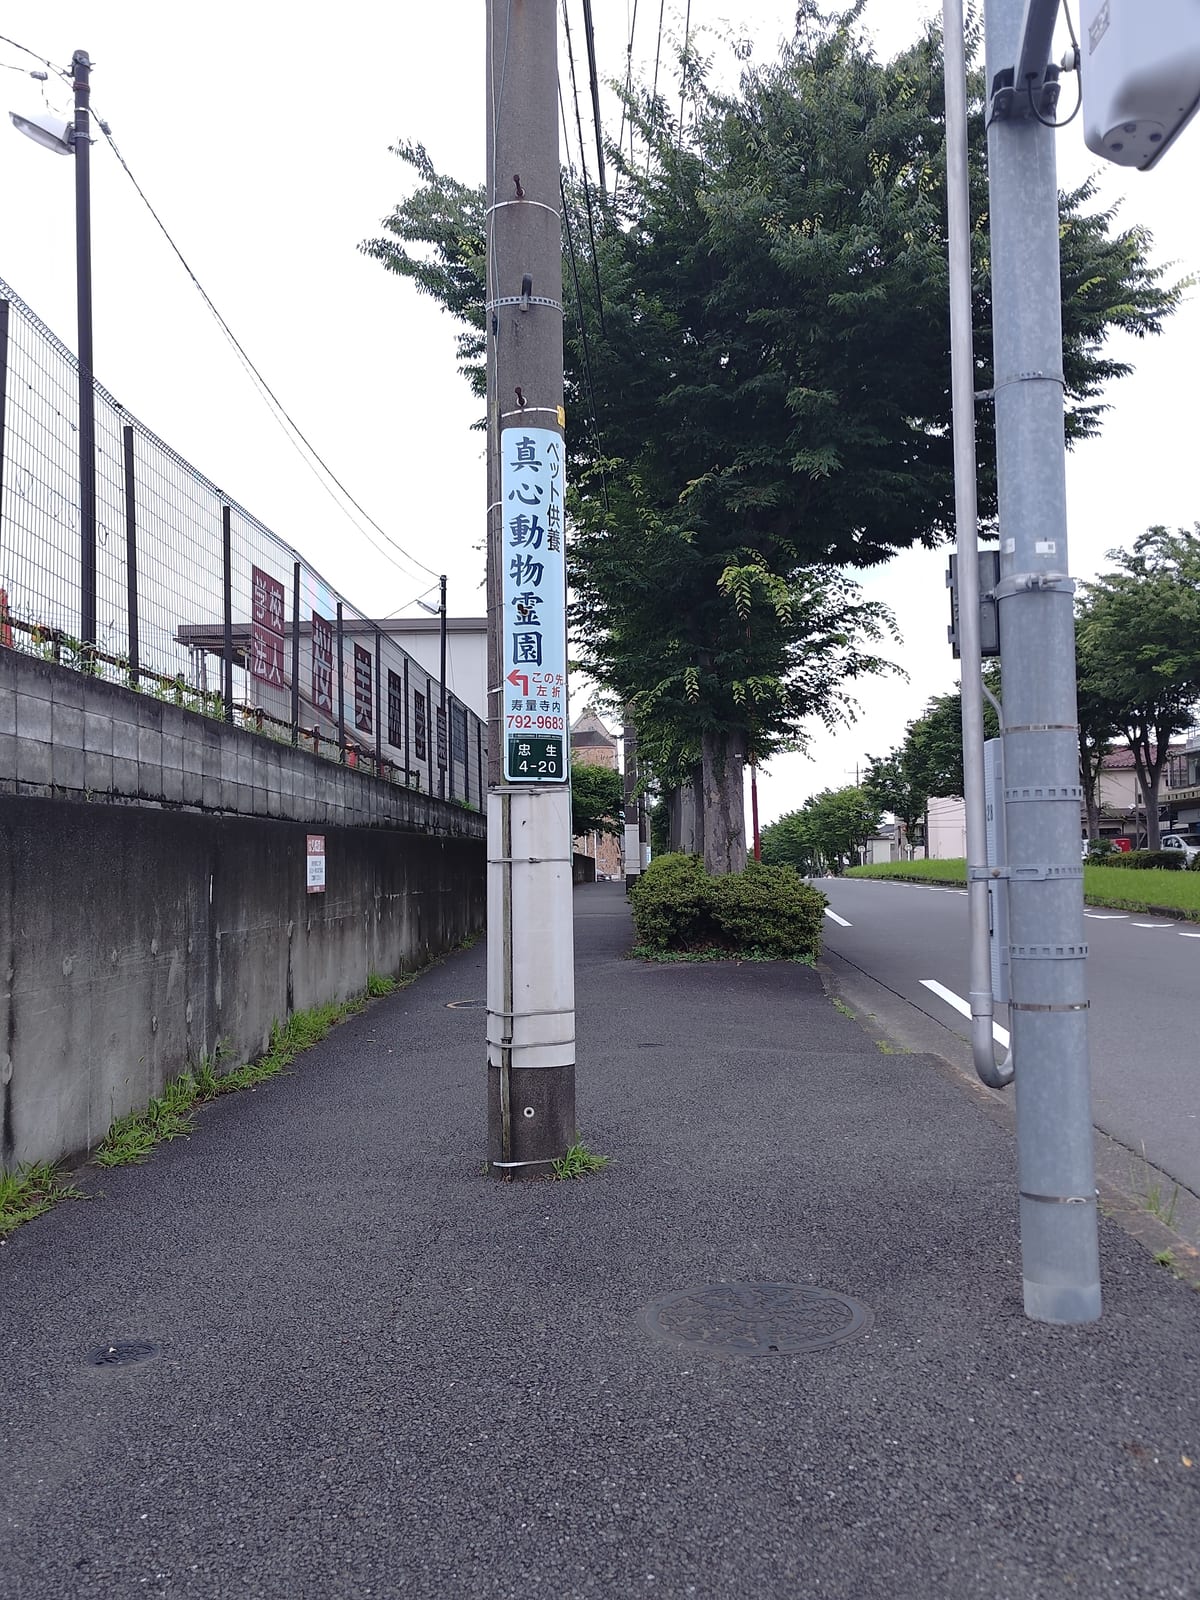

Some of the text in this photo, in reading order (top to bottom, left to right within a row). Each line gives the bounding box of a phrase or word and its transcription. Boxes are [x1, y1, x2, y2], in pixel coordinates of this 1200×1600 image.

[547, 442, 561, 553] ペット供養
[509, 436, 545, 667] 真心動物霊園
[255, 575, 282, 630] 学校
[255, 632, 281, 683] 法人
[532, 672, 563, 686] この先
[537, 685, 561, 698] 左折
[511, 699, 561, 713] 寿量寺内
[507, 715, 564, 731] 792-9683
[518, 743, 557, 757] 忠生
[519, 760, 557, 773] 4-20
